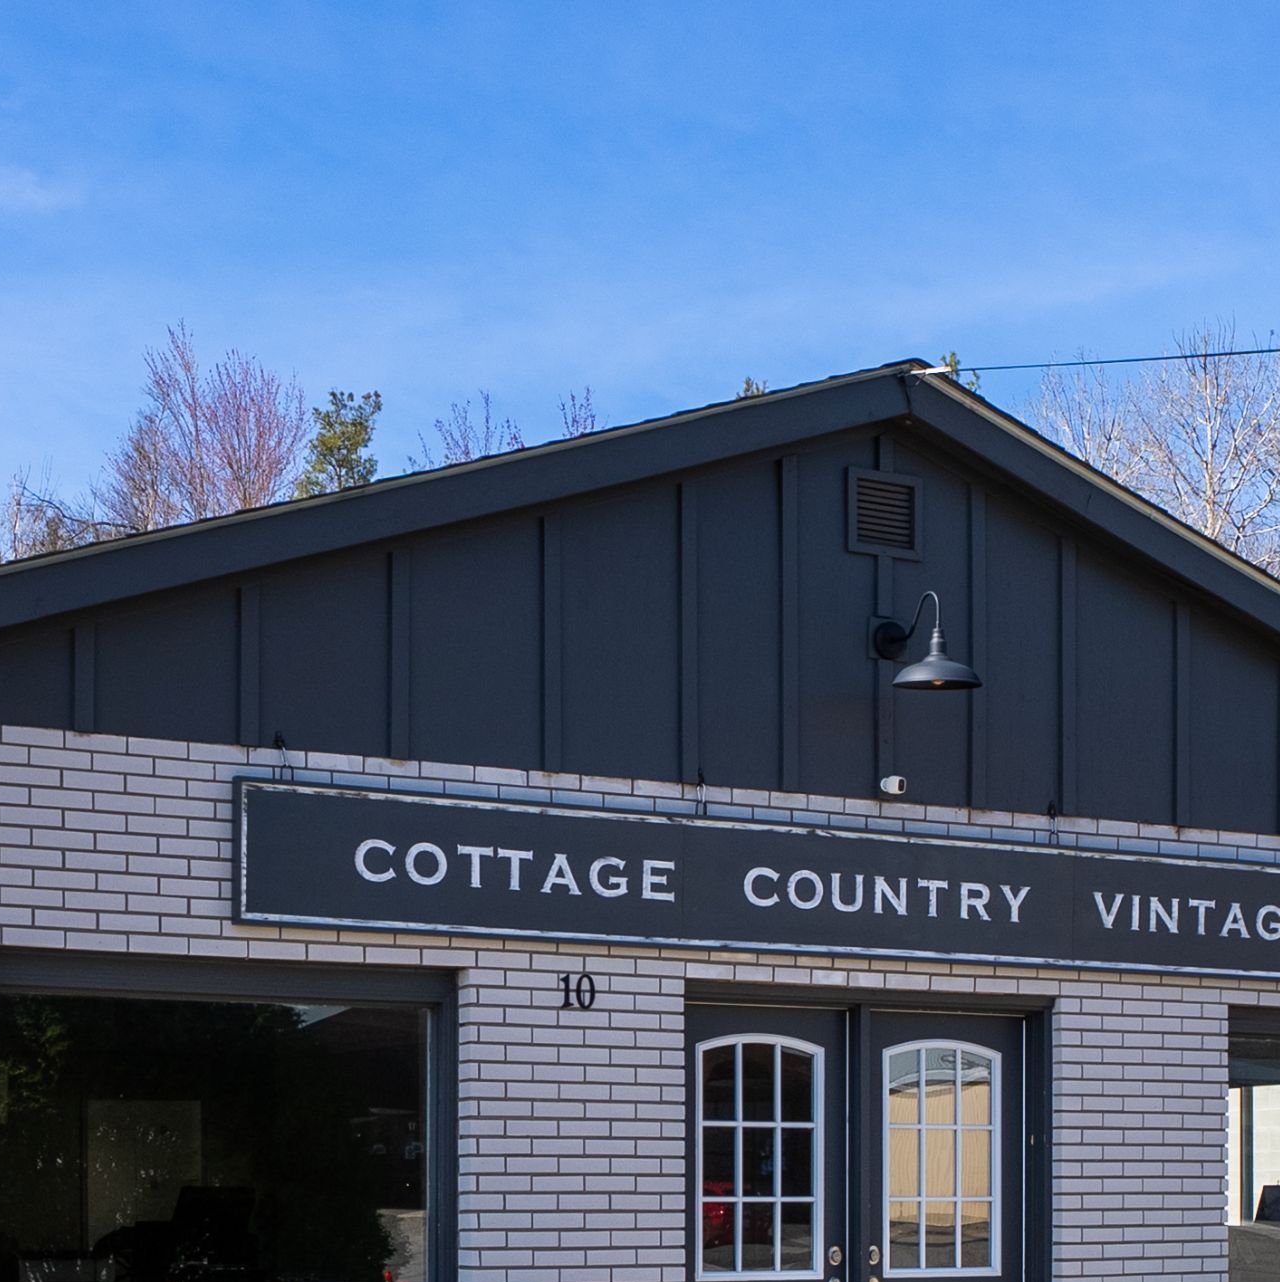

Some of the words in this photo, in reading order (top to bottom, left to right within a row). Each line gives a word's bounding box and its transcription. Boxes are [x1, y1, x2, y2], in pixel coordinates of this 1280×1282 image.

[354, 838, 676, 903] COTTAGE
[743, 866, 1031, 923] COUNTRY
[558, 972, 596, 1010] 10
